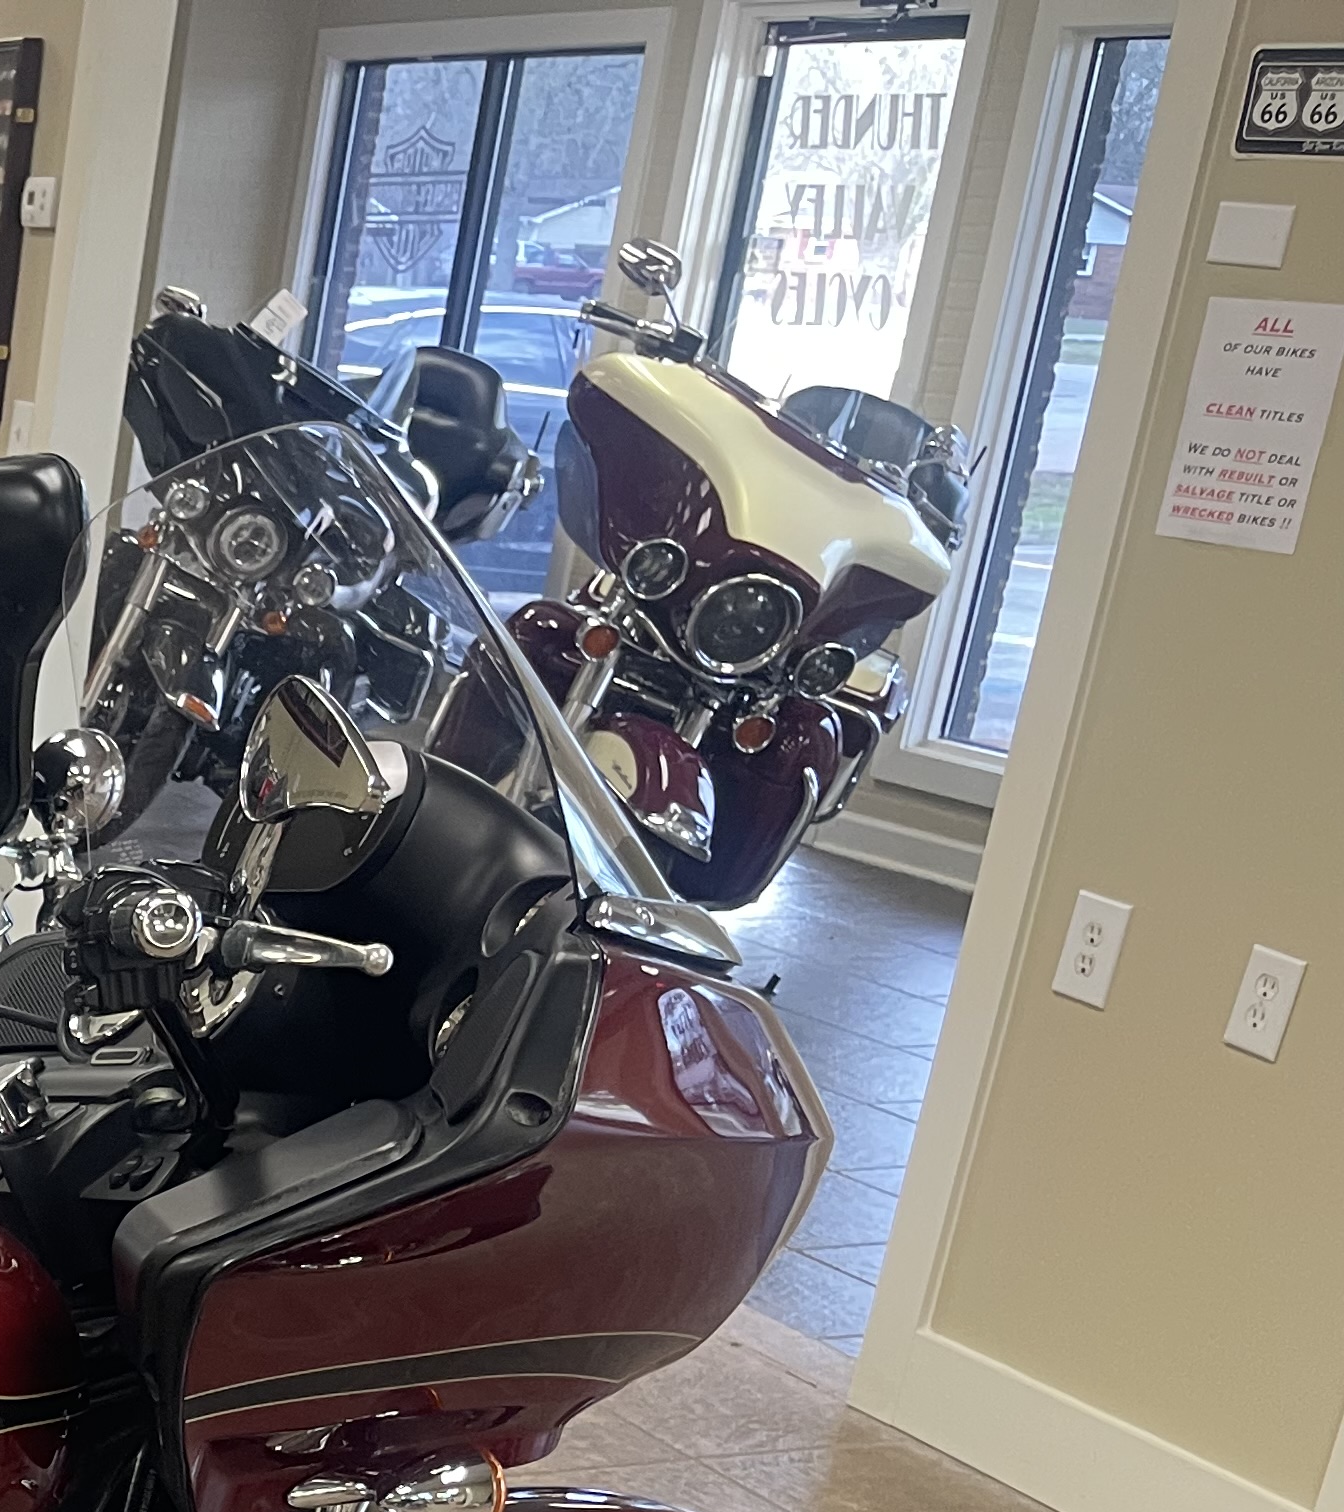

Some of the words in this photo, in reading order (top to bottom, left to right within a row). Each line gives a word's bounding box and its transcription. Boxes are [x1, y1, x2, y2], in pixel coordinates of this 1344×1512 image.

[1261, 102, 1288, 124] 66
[1310, 103, 1338, 125] 66
[1254, 316, 1294, 334] ALL
[1223, 342, 1242, 352] OF
[1243, 344, 1273, 356] OUR
[1275, 346, 1317, 359] BIKES
[1245, 365, 1282, 378] HAVE
[1205, 402, 1256, 418] CLEAN
[1259, 408, 1305, 424] TITLES
[1187, 442, 1209, 456] WE
[1211, 446, 1231, 458] DO
[1234, 447, 1267, 462] NOT
[1267, 453, 1301, 467] DEAL
[1182, 463, 1215, 478] WITH
[1217, 468, 1276, 485] REBUILT
[1278, 476, 1299, 488] OR
[1174, 483, 1236, 501] SALVAGE
[1238, 491, 1275, 506] TITLE
[1277, 497, 1297, 509] OR
[1171, 504, 1235, 522] WRECKED
[1236, 513, 1277, 528] BIKES
